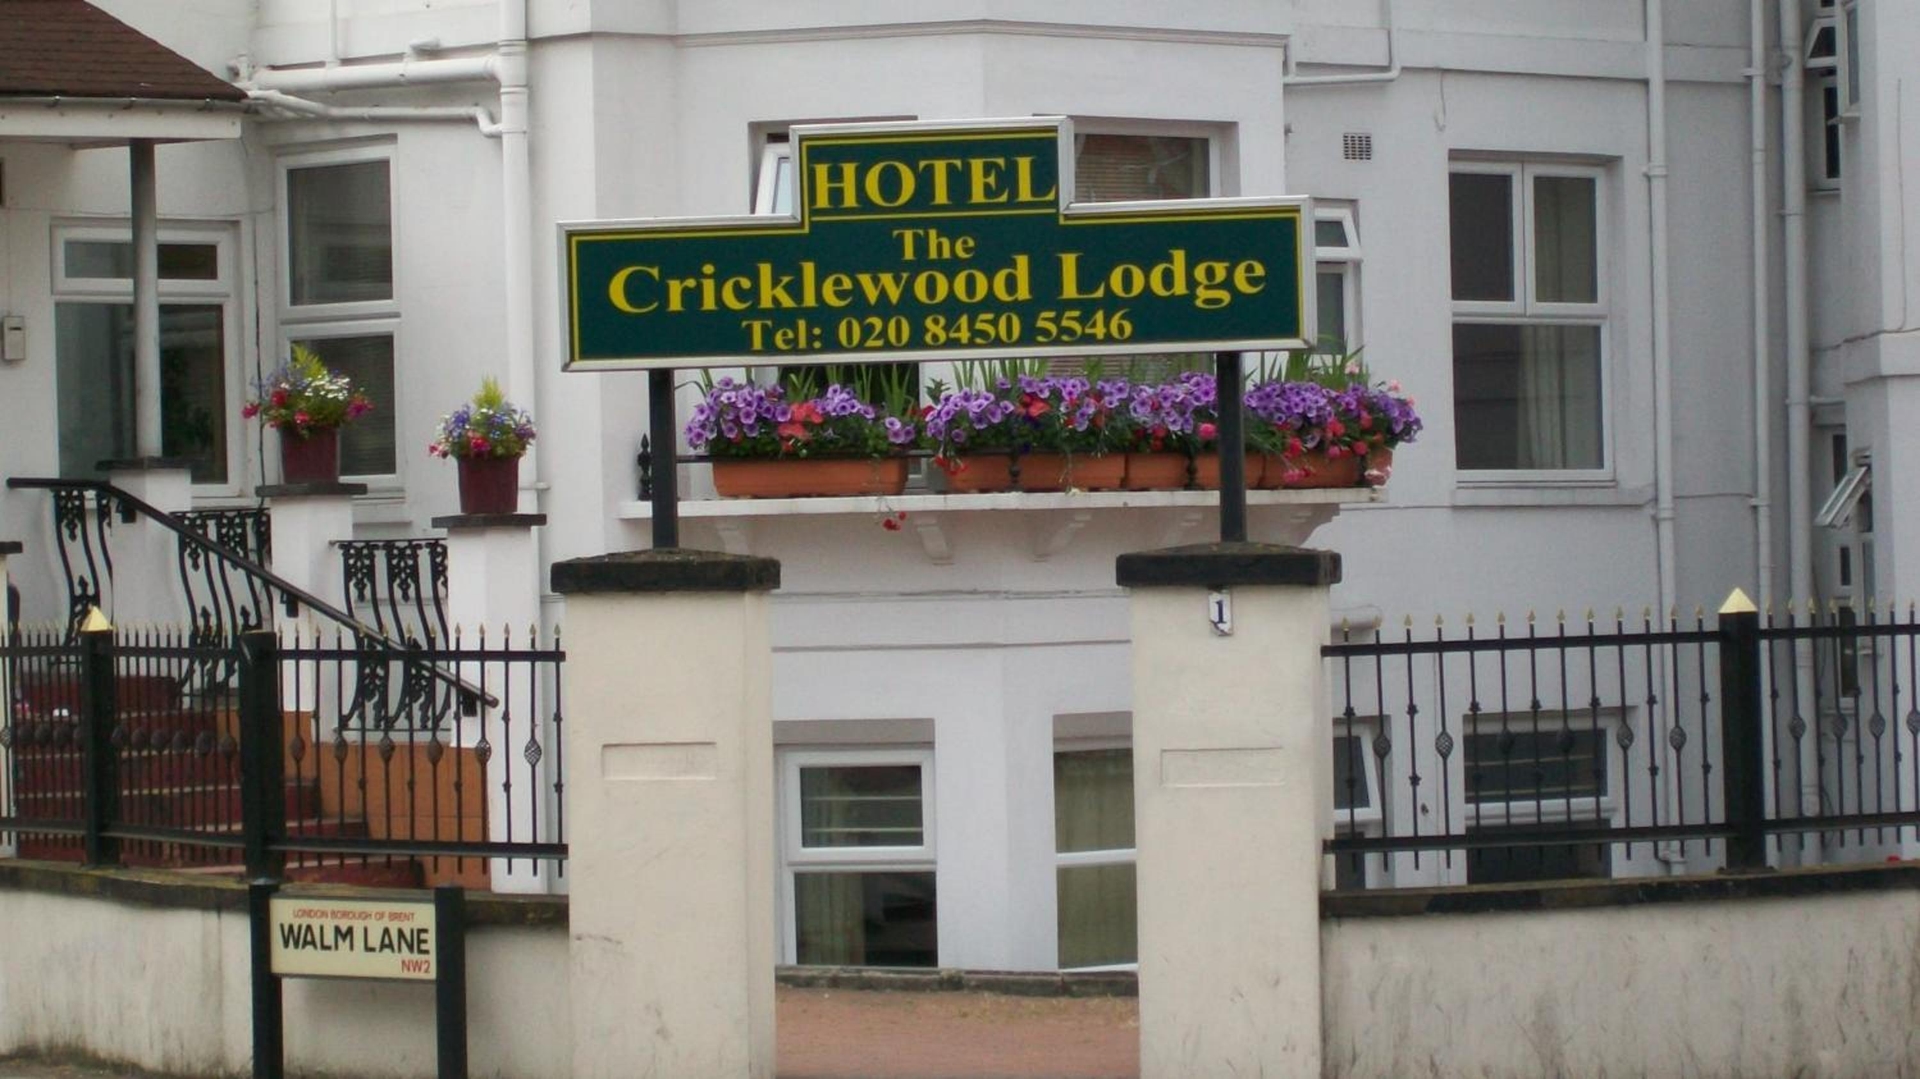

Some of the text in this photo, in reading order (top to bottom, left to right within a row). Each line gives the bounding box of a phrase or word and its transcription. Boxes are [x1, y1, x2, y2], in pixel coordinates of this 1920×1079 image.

[812, 155, 1057, 210] HOTEL
[892, 228, 975, 262] The
[607, 249, 1267, 314] Cricklewood Lodge
[741, 308, 1133, 352] Tel: 020 8450 5546
[1214, 599, 1228, 625] 1
[292, 908, 415, 923] LONDON BOROUGH OF BRENT
[279, 923, 431, 955] WALM LANE
[401, 959, 431, 974] NW2
